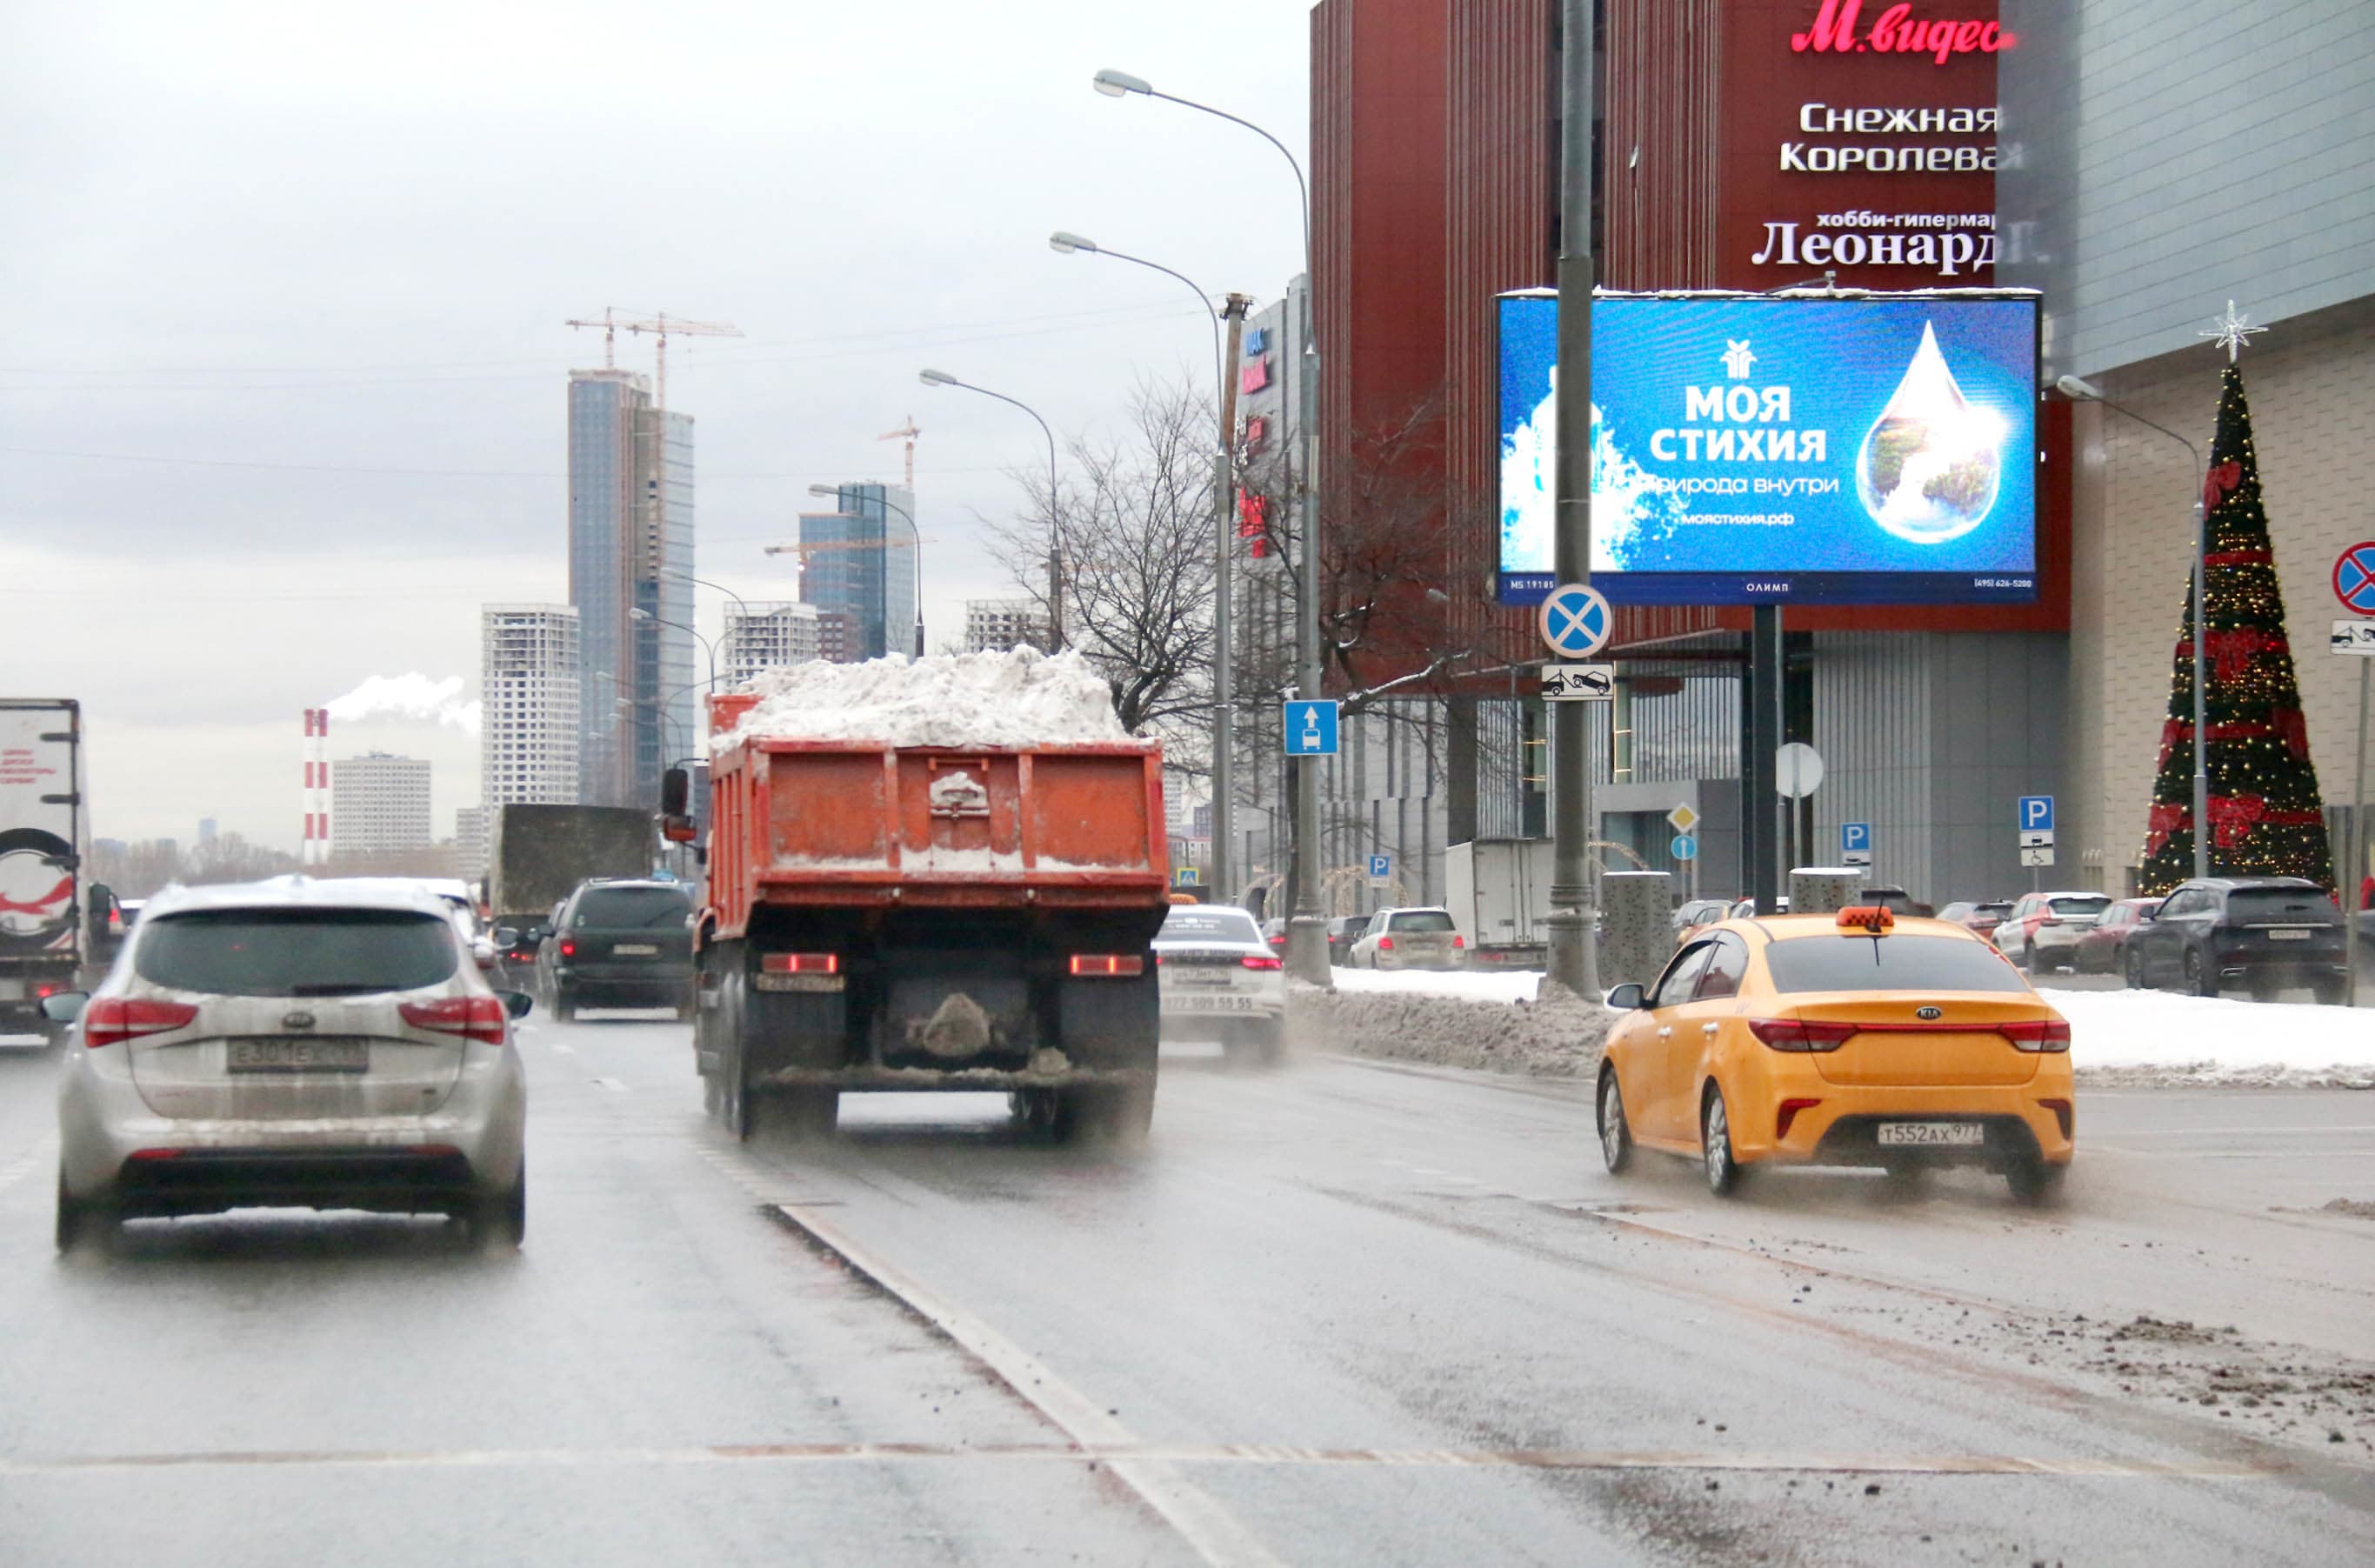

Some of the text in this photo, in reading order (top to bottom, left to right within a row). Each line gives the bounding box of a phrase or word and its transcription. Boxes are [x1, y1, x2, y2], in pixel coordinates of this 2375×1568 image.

[1799, 103, 1998, 132] Снежная
[1685, 385, 1791, 422] МОЯ
[1650, 429, 1826, 462] СТИХИЯ
[1753, 477, 1839, 497] внутри
[1511, 581, 1524, 590] MS
[1746, 584, 1789, 592] ОЛИМП
[2029, 800, 2047, 827] P
[1847, 826, 1864, 849] P
[1375, 857, 1386, 874] P
[1238, 998, 1252, 1010] 55
[1920, 1009, 1938, 1018] KIA
